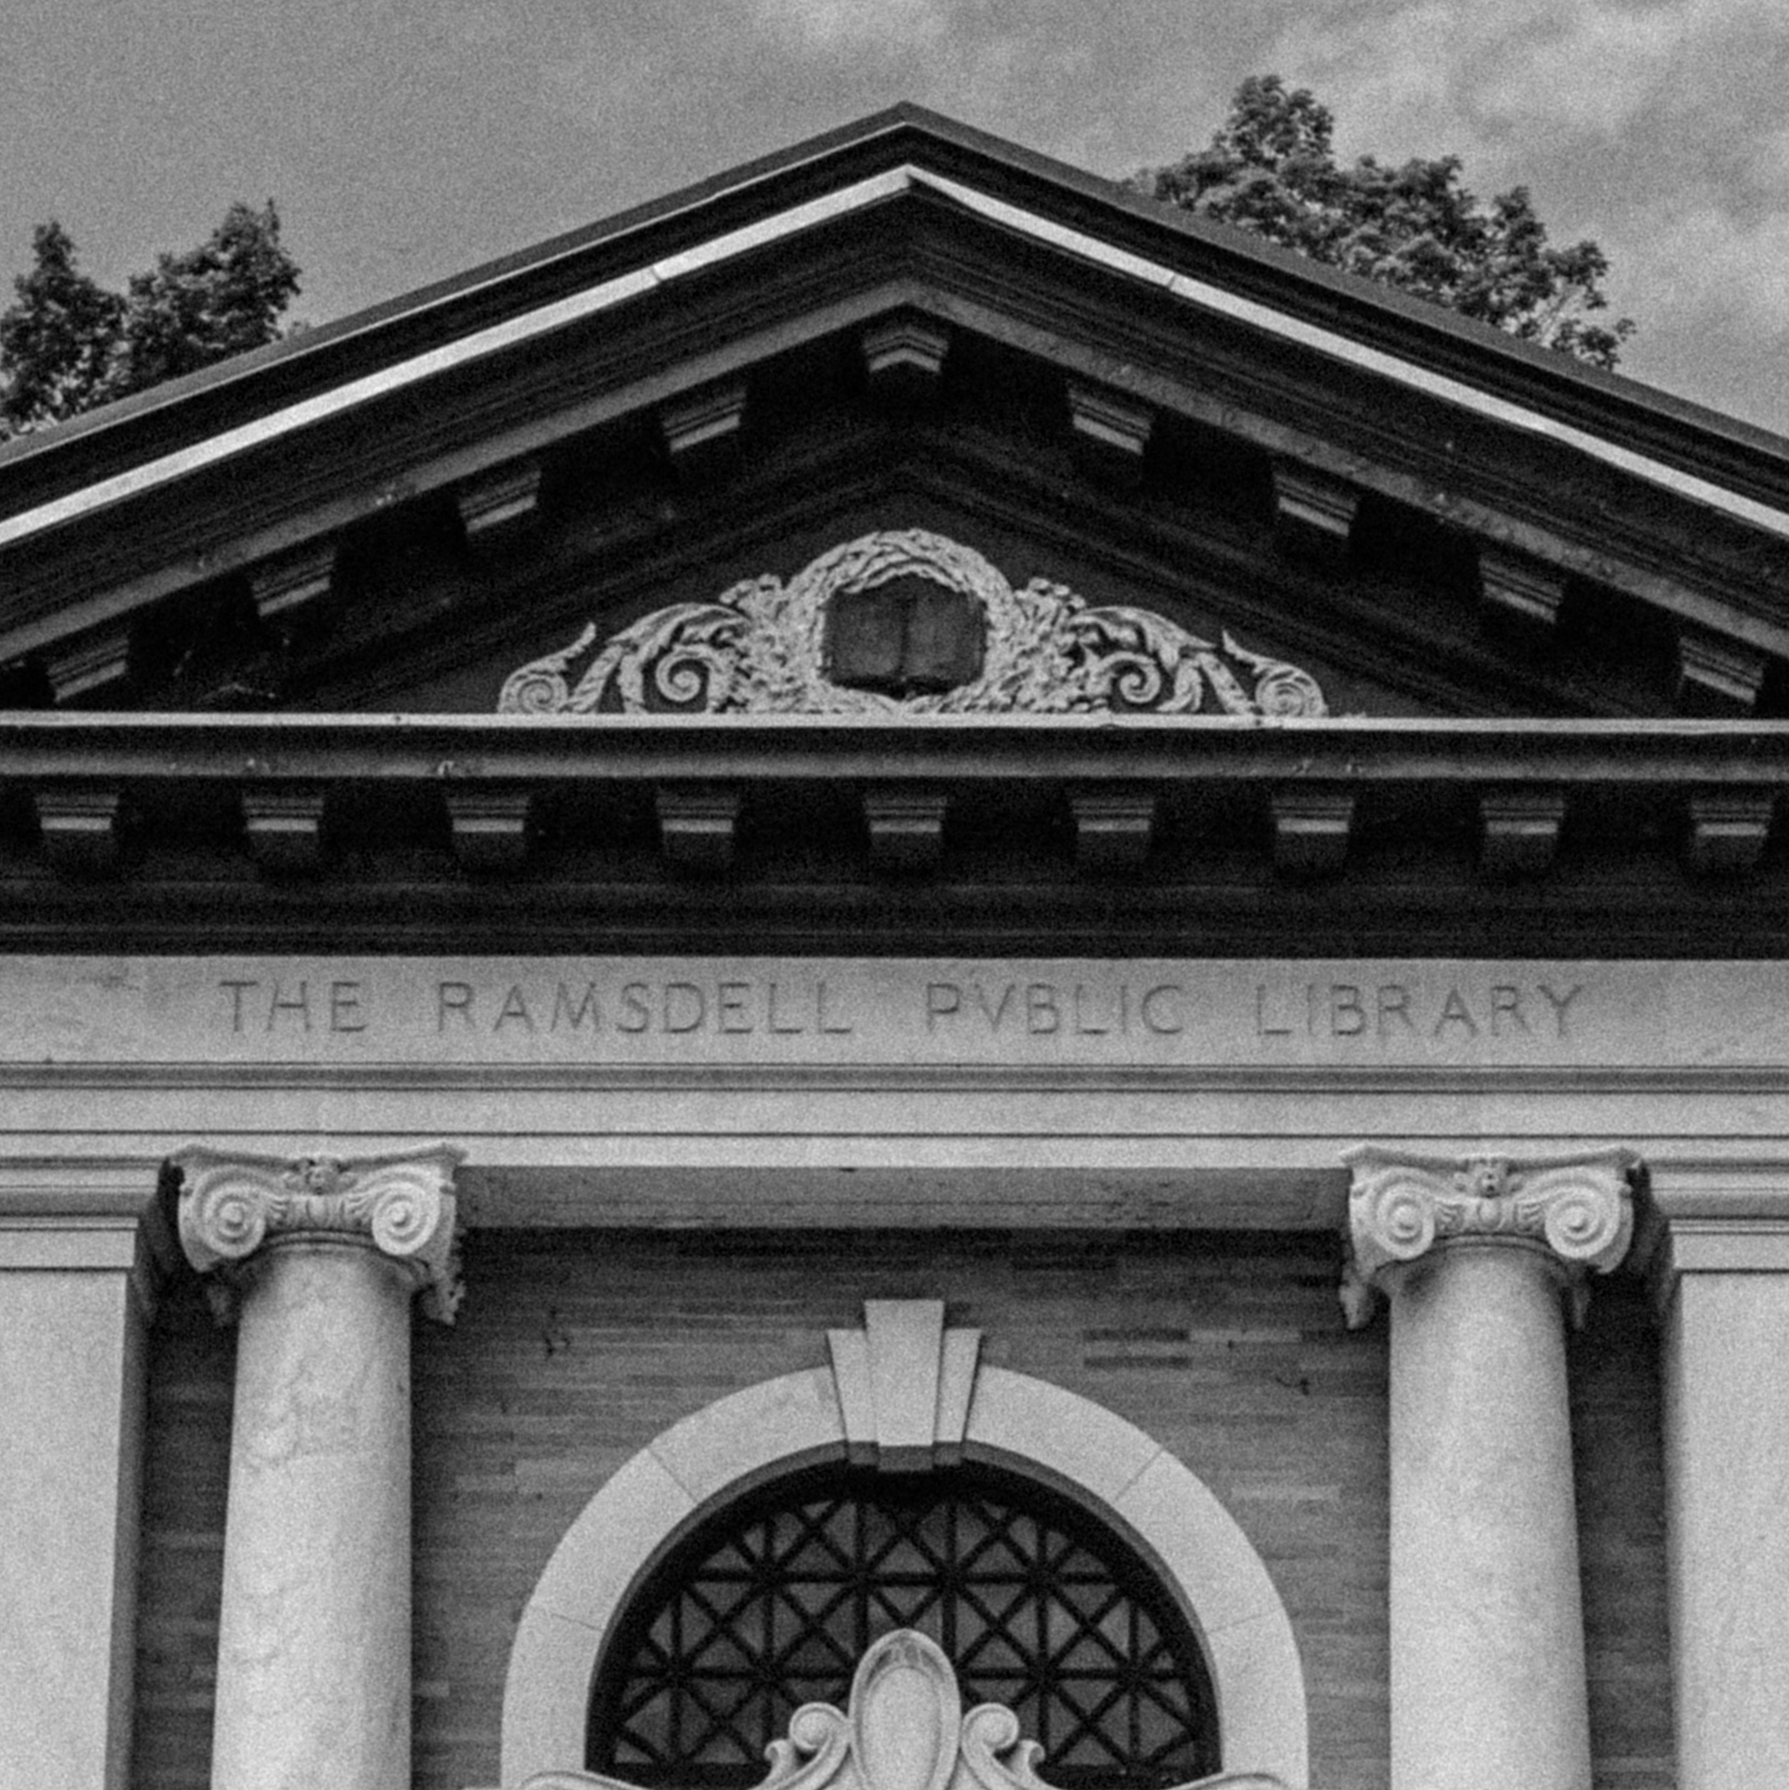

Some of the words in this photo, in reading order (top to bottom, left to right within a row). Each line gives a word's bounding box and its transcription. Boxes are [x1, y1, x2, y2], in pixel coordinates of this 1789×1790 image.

[218, 979, 367, 1033] THE
[437, 980, 853, 1035] RAMSDELL
[925, 982, 1184, 1036] PVBLIC
[1256, 983, 1583, 1038] LIBRARY
